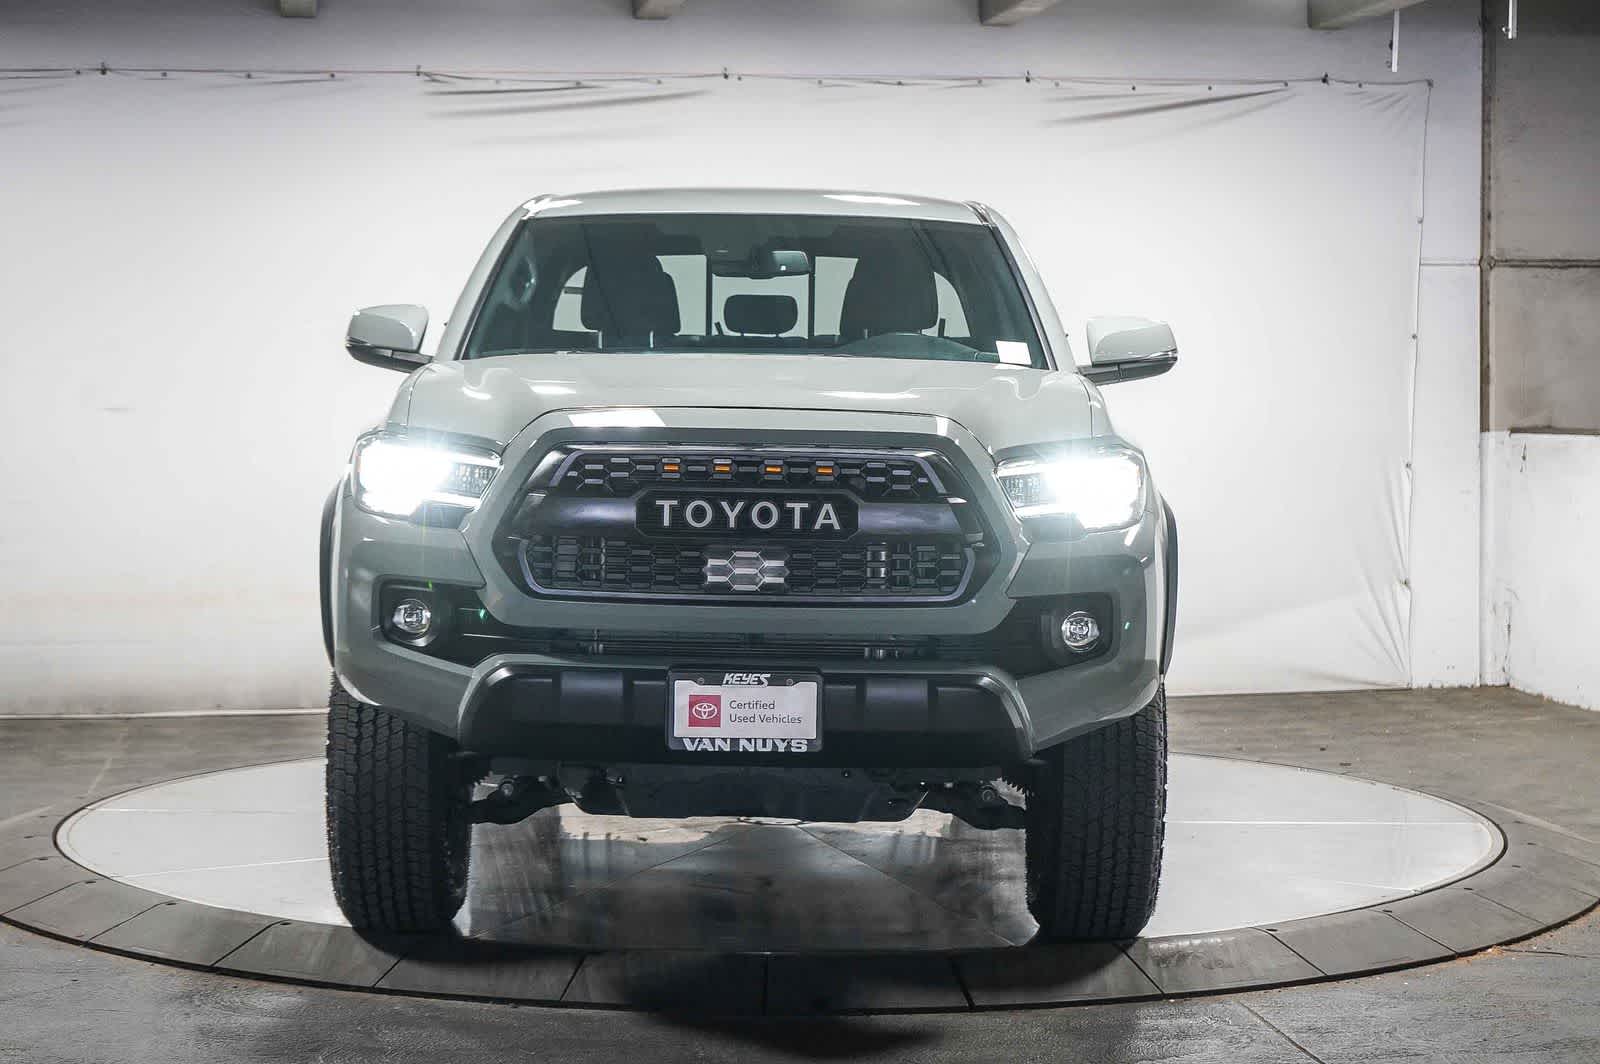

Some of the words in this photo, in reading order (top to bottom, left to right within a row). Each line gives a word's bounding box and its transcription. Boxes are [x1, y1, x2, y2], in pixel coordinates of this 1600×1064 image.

[656, 500, 841, 530] TOYOTA
[722, 673, 771, 687] KEYES
[729, 699, 775, 710] Certified
[729, 713, 756, 723] Used
[759, 714, 802, 724] Vehicles
[682, 738, 730, 752] VAN
[739, 738, 808, 753] NUYS
